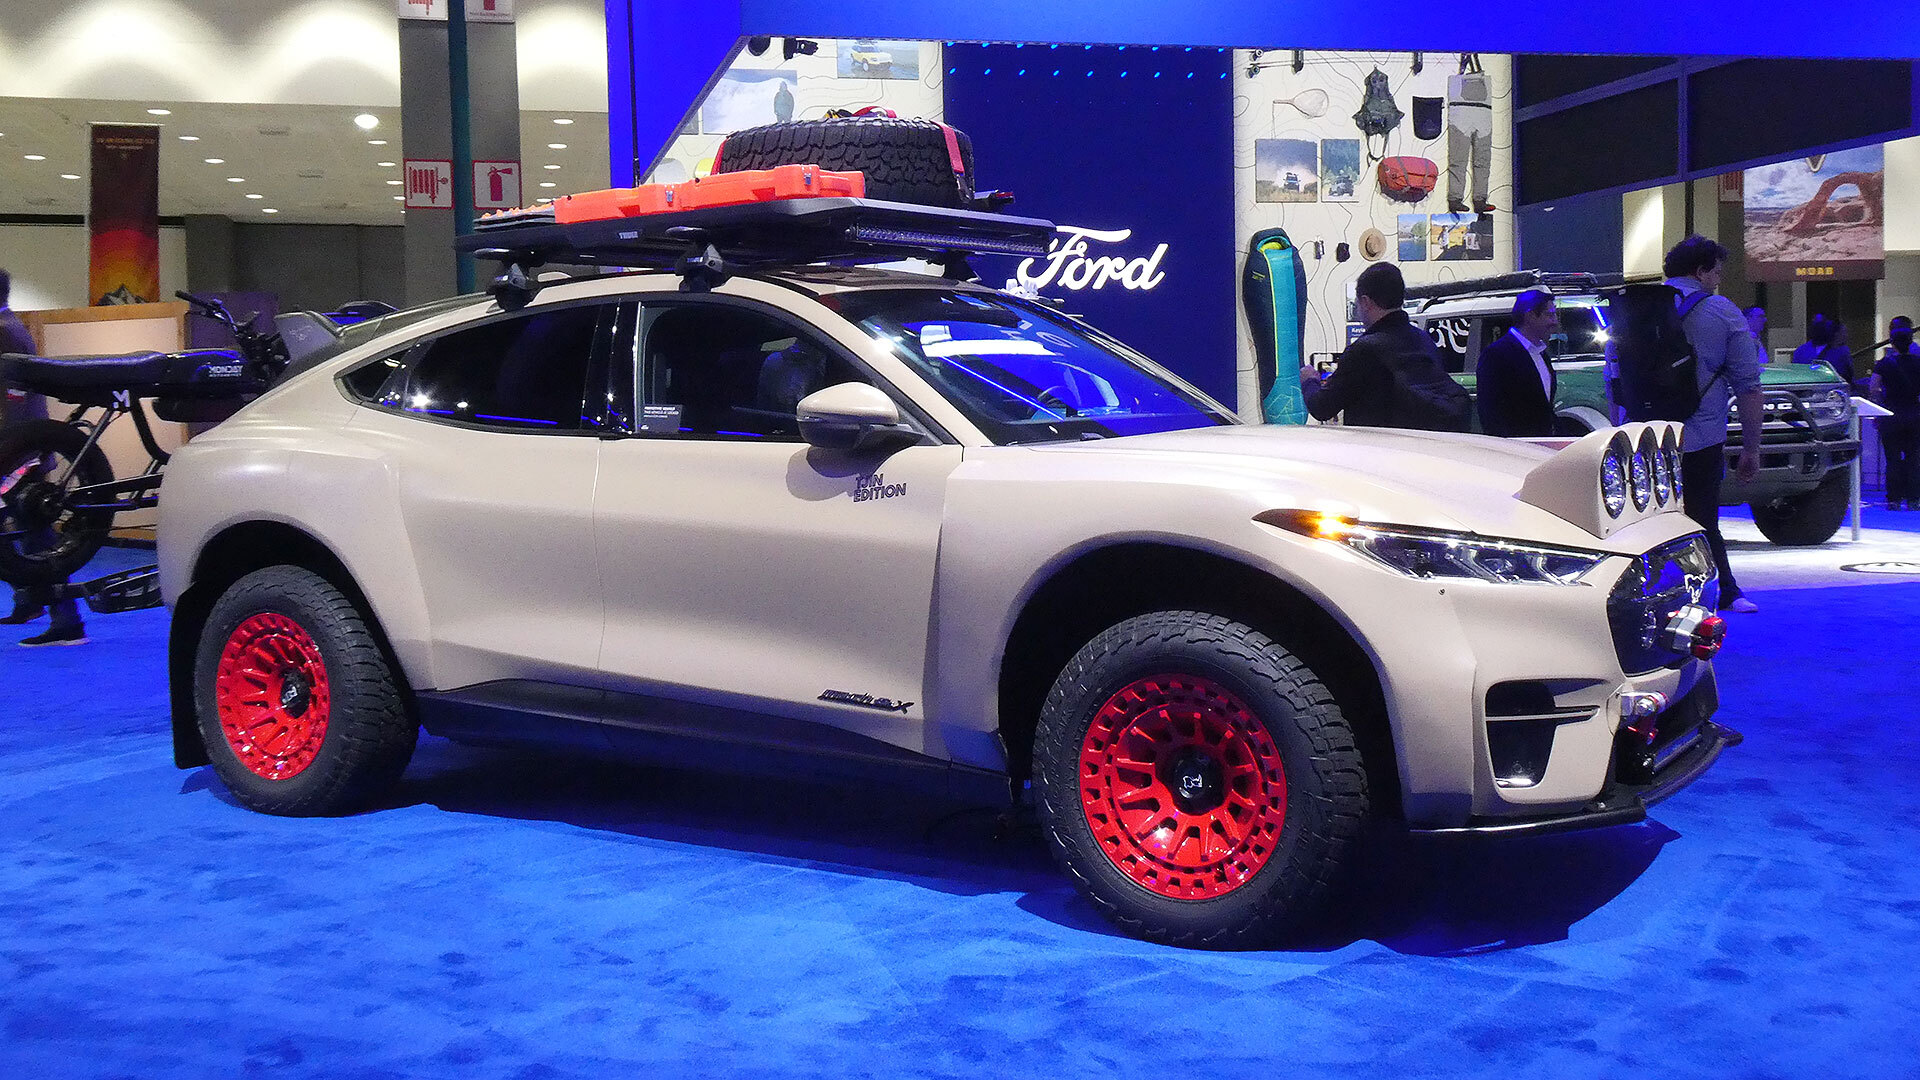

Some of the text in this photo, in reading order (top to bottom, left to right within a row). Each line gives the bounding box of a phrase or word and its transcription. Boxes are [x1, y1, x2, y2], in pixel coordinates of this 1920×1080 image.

[1016, 225, 1169, 290] Ford
[1796, 267, 1834, 276] MOAB
[208, 365, 243, 374] MONDAY
[855, 473, 883, 489] TJIN
[853, 482, 907, 502] EDITION
